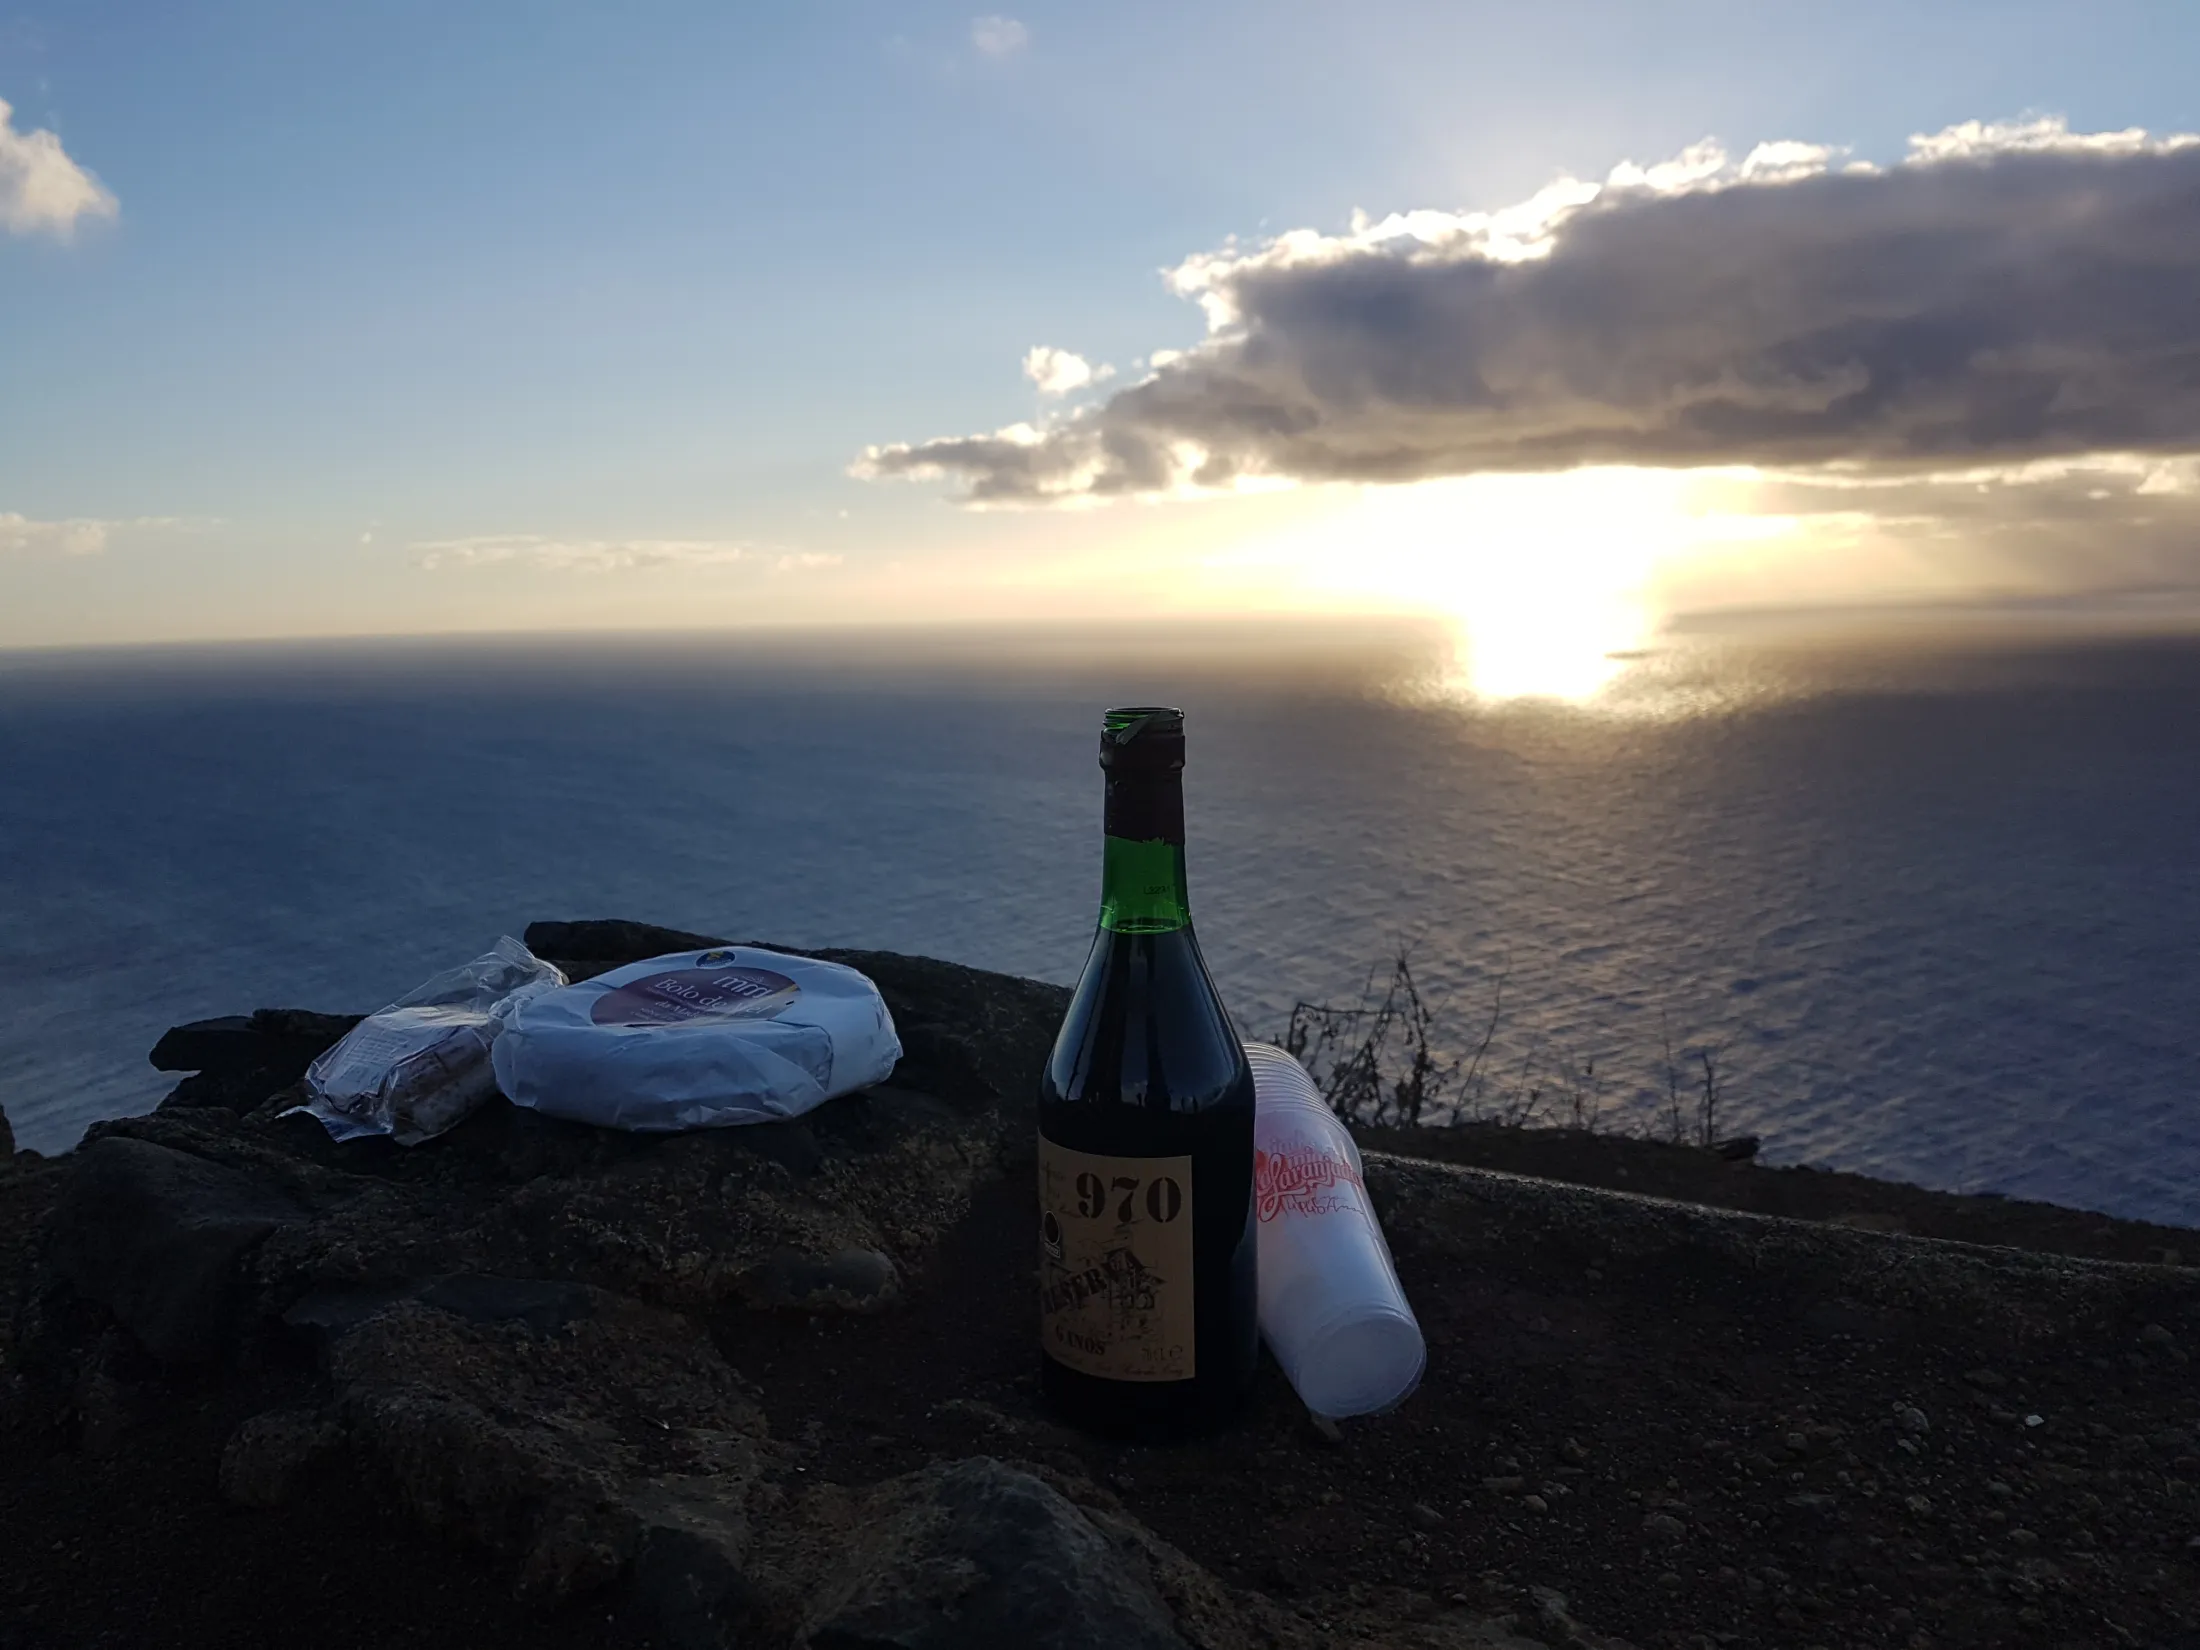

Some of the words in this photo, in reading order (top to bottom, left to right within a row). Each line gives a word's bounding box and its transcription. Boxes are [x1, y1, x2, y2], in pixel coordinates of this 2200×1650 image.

[654, 978, 699, 999] Bolo
[698, 996, 727, 1010] de
[1076, 1172, 1182, 1223] 970
[1066, 1330, 1105, 1356] ANOS
